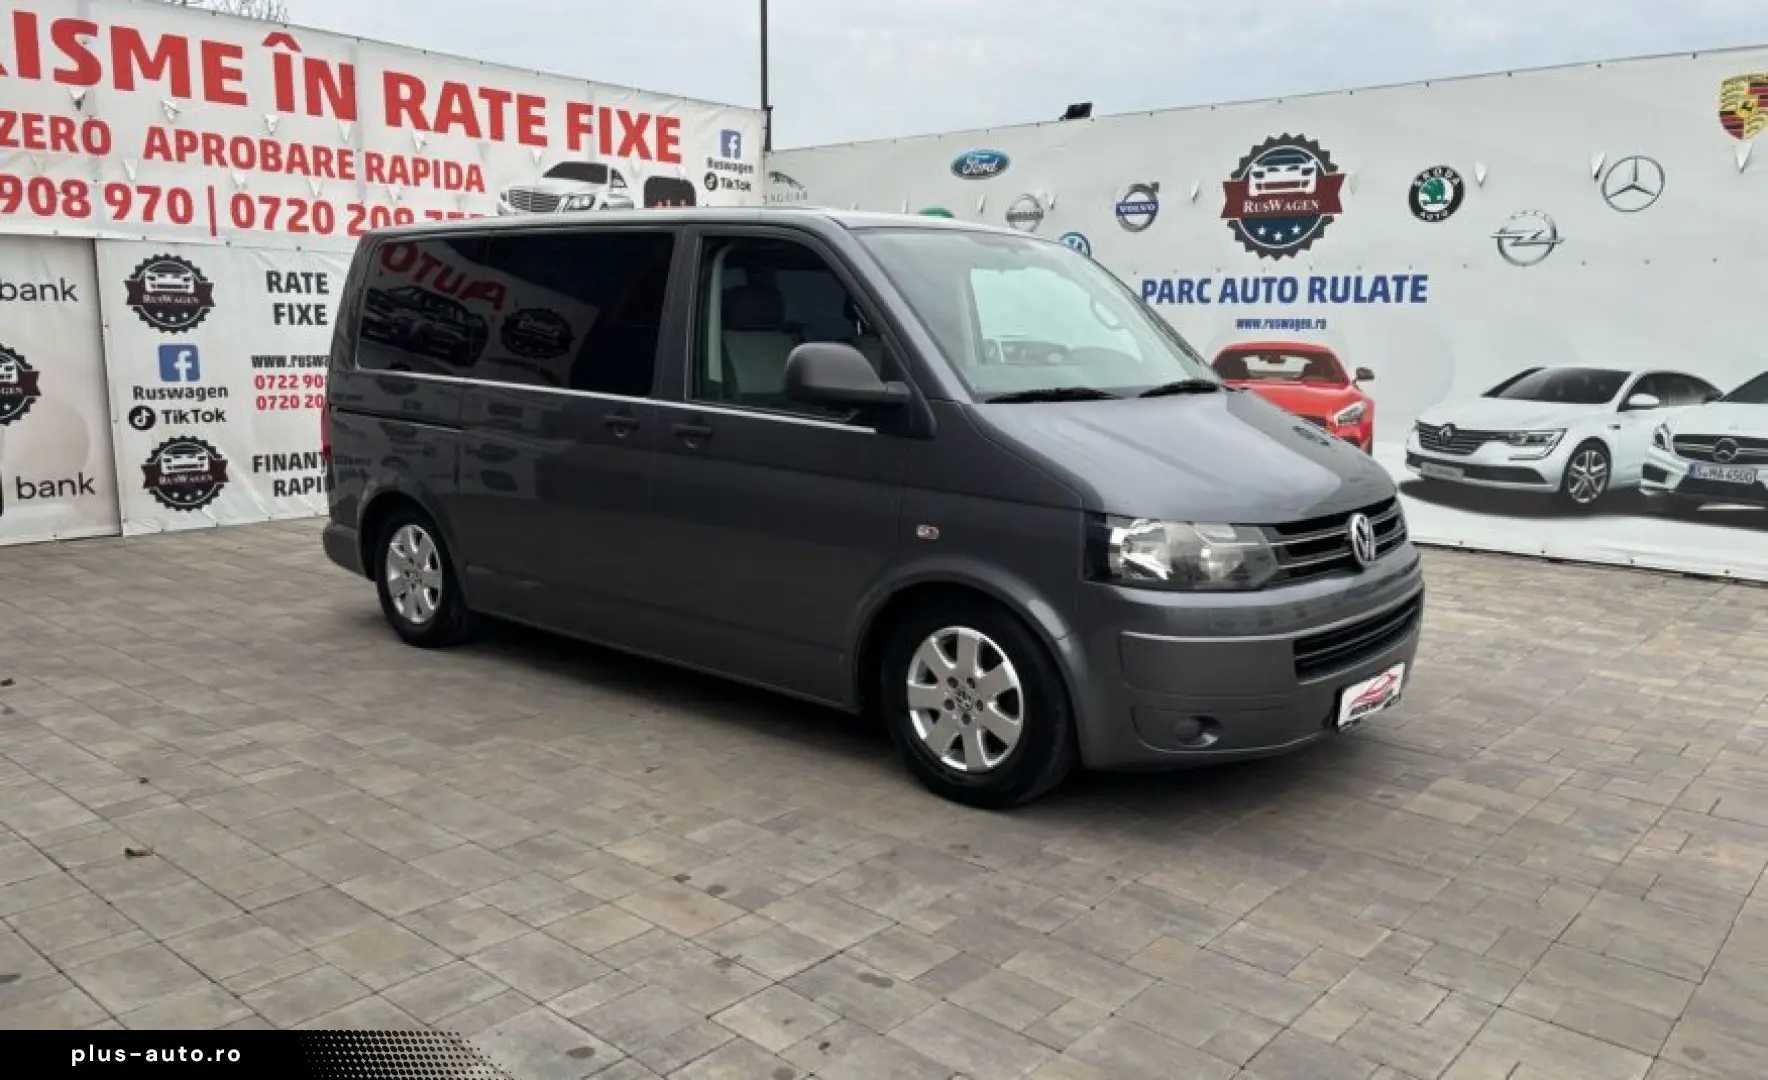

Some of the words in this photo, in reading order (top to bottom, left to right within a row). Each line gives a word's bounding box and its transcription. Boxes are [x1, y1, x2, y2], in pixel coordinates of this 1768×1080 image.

[0, 10, 248, 107] ISME
[261, 31, 357, 121] ÎN
[383, 70, 548, 148] RATE
[565, 101, 682, 164] FIXE
[0, 110, 111, 156] ZERO
[143, 126, 356, 180] APROBARE
[365, 152, 485, 193] RAPIDA
[707, 156, 754, 175] Ruswagen
[720, 177, 752, 192] TikTok
[0, 175, 91, 218] 908
[104, 182, 194, 225] 970
[230, 193, 335, 235] 0720
[0, 276, 79, 302] bank
[266, 270, 330, 294] RATE
[1142, 278, 1212, 305] PARC
[1218, 275, 1298, 305] AUTO
[1307, 274, 1429, 304] RULATE
[273, 303, 328, 326] FIXE
[1236, 318, 1327, 332] www.ruswagen.ro
[133, 385, 229, 402] Ruswagen
[254, 374, 299, 390] 0722
[255, 394, 300, 410] 0720
[161, 408, 227, 425] TikTok
[16, 471, 96, 501] bank
